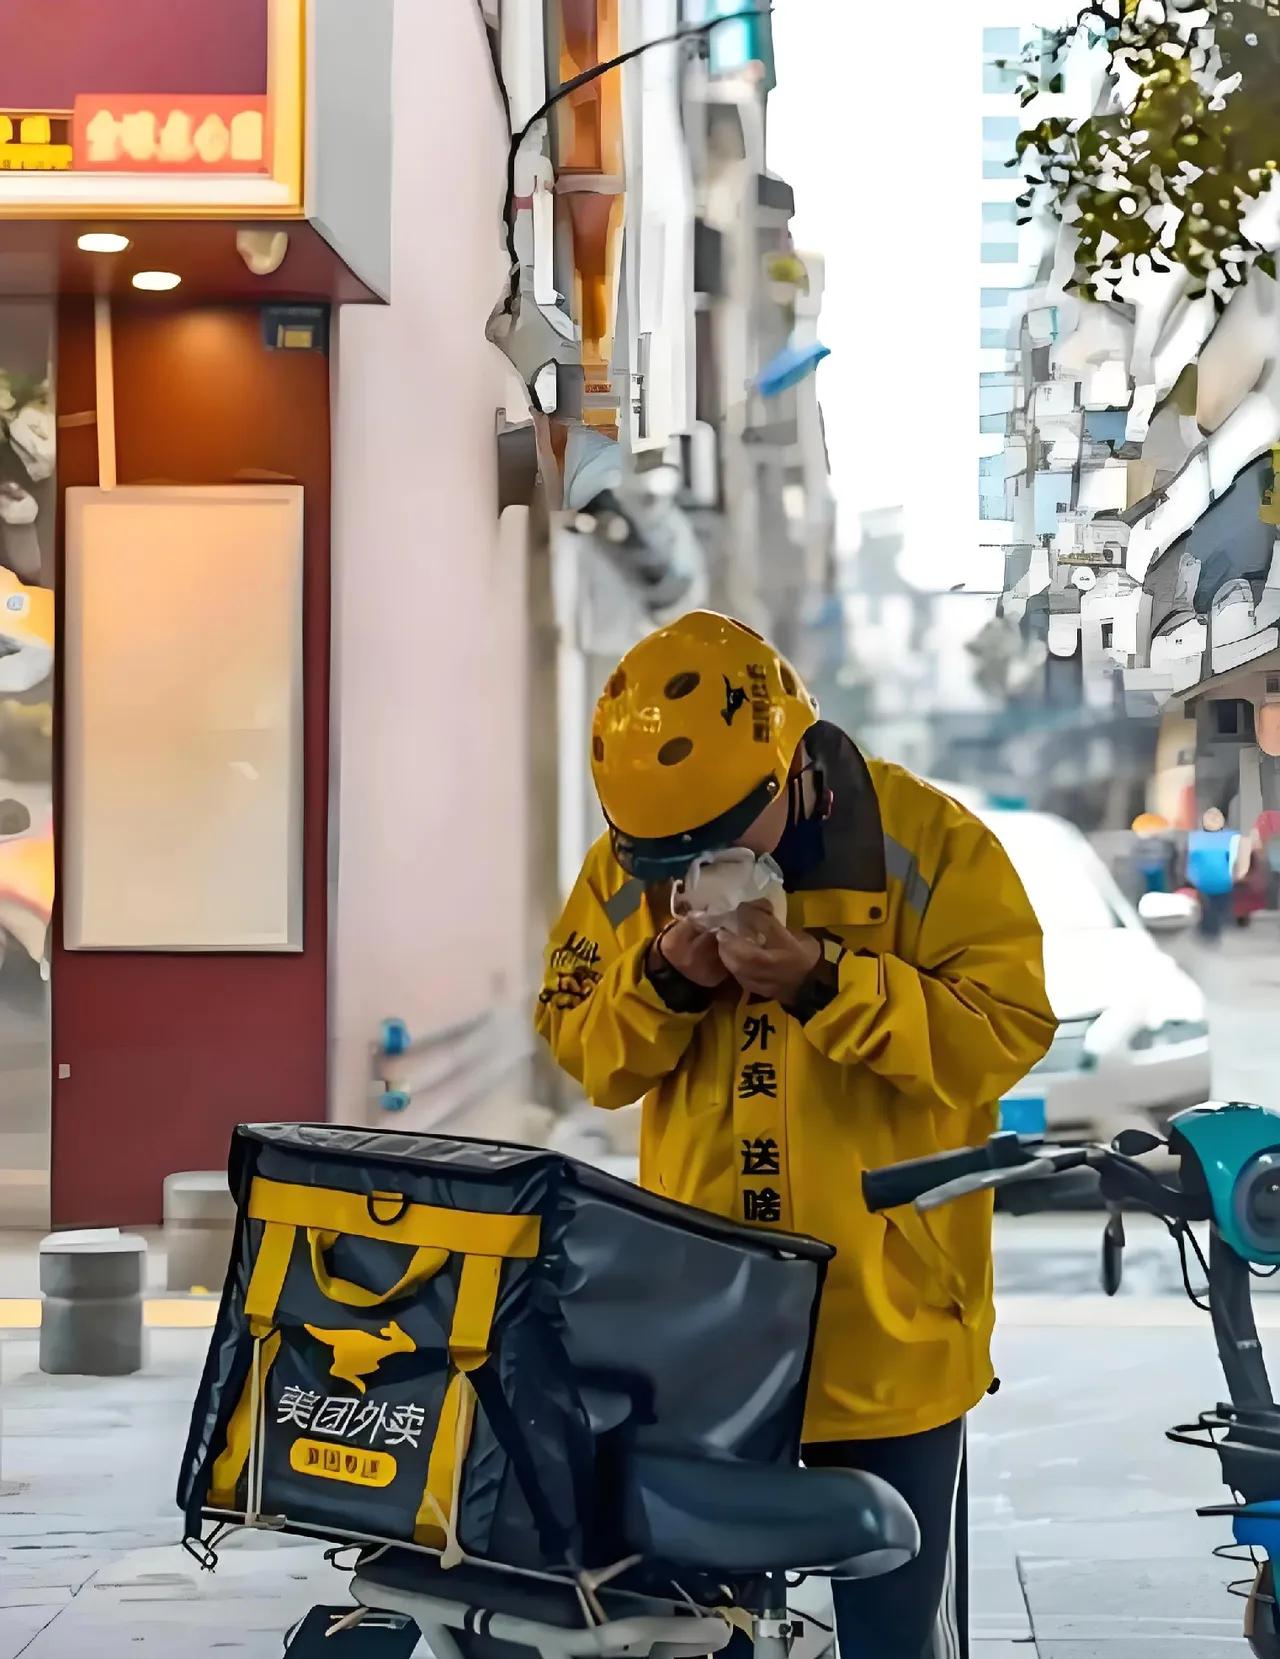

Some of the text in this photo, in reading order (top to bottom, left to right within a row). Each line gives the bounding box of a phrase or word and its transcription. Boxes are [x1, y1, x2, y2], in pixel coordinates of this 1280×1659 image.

[738, 1014, 780, 1222] 外卖 送啥
[277, 1385, 425, 1448] 美团外卖
